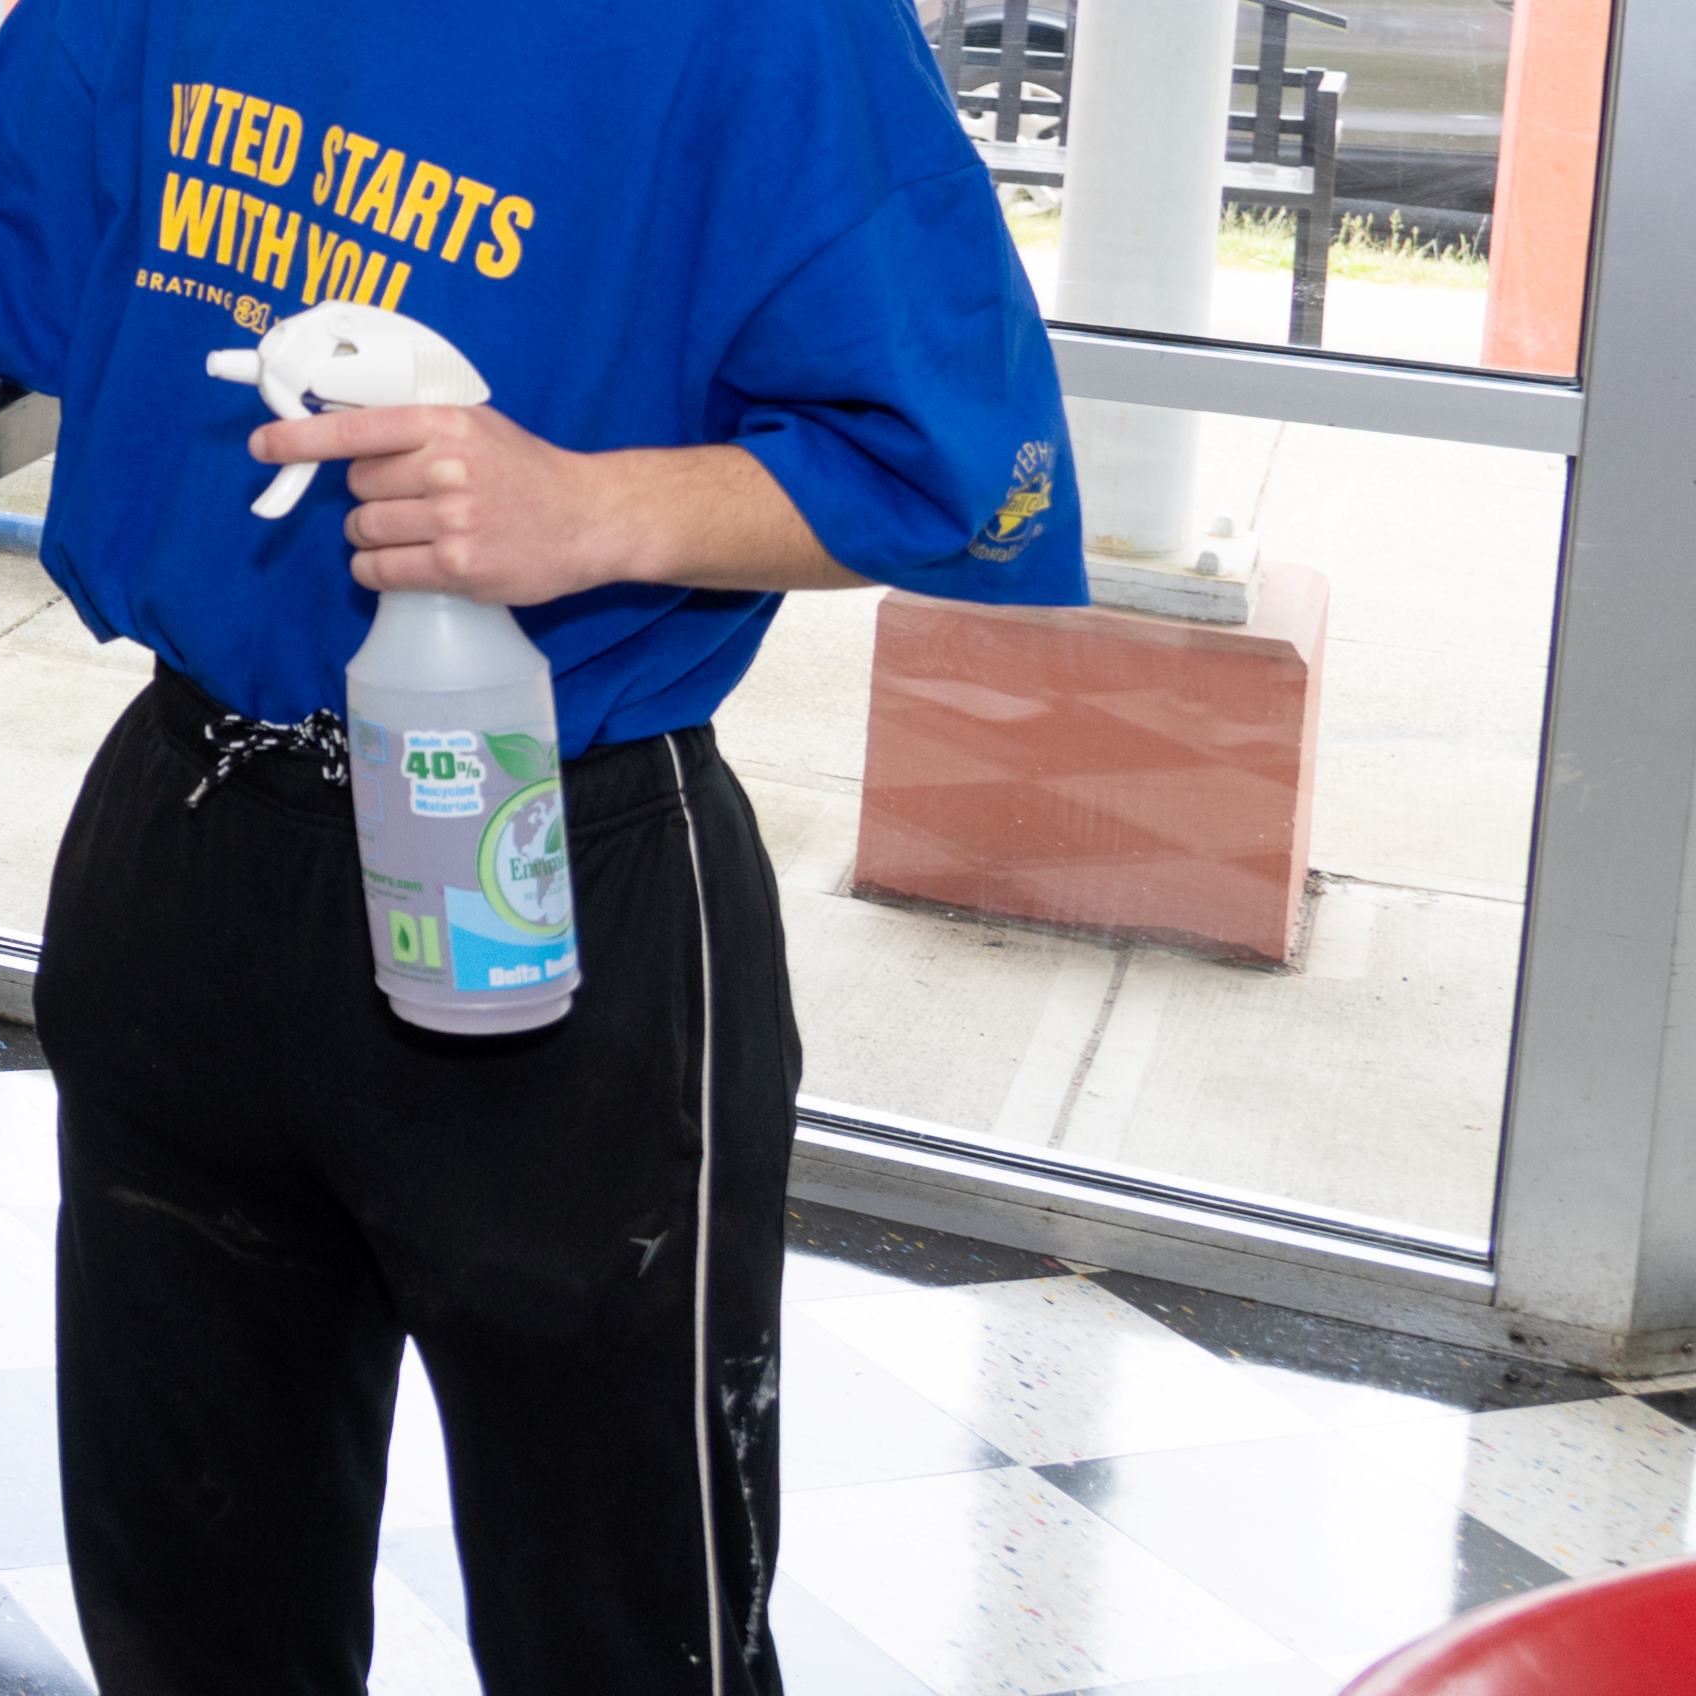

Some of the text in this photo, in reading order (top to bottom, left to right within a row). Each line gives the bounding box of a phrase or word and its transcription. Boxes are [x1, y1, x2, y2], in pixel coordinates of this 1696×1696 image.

[312, 123, 535, 281] STARTS
[158, 170, 413, 313] WITH YOU
[233, 294, 272, 336] 31
[409, 735, 472, 747] Made with
[406, 751, 481, 780] 40%
[416, 784, 476, 798] Recycled
[415, 800, 479, 813] Materials
[488, 964, 541, 987] Delta
